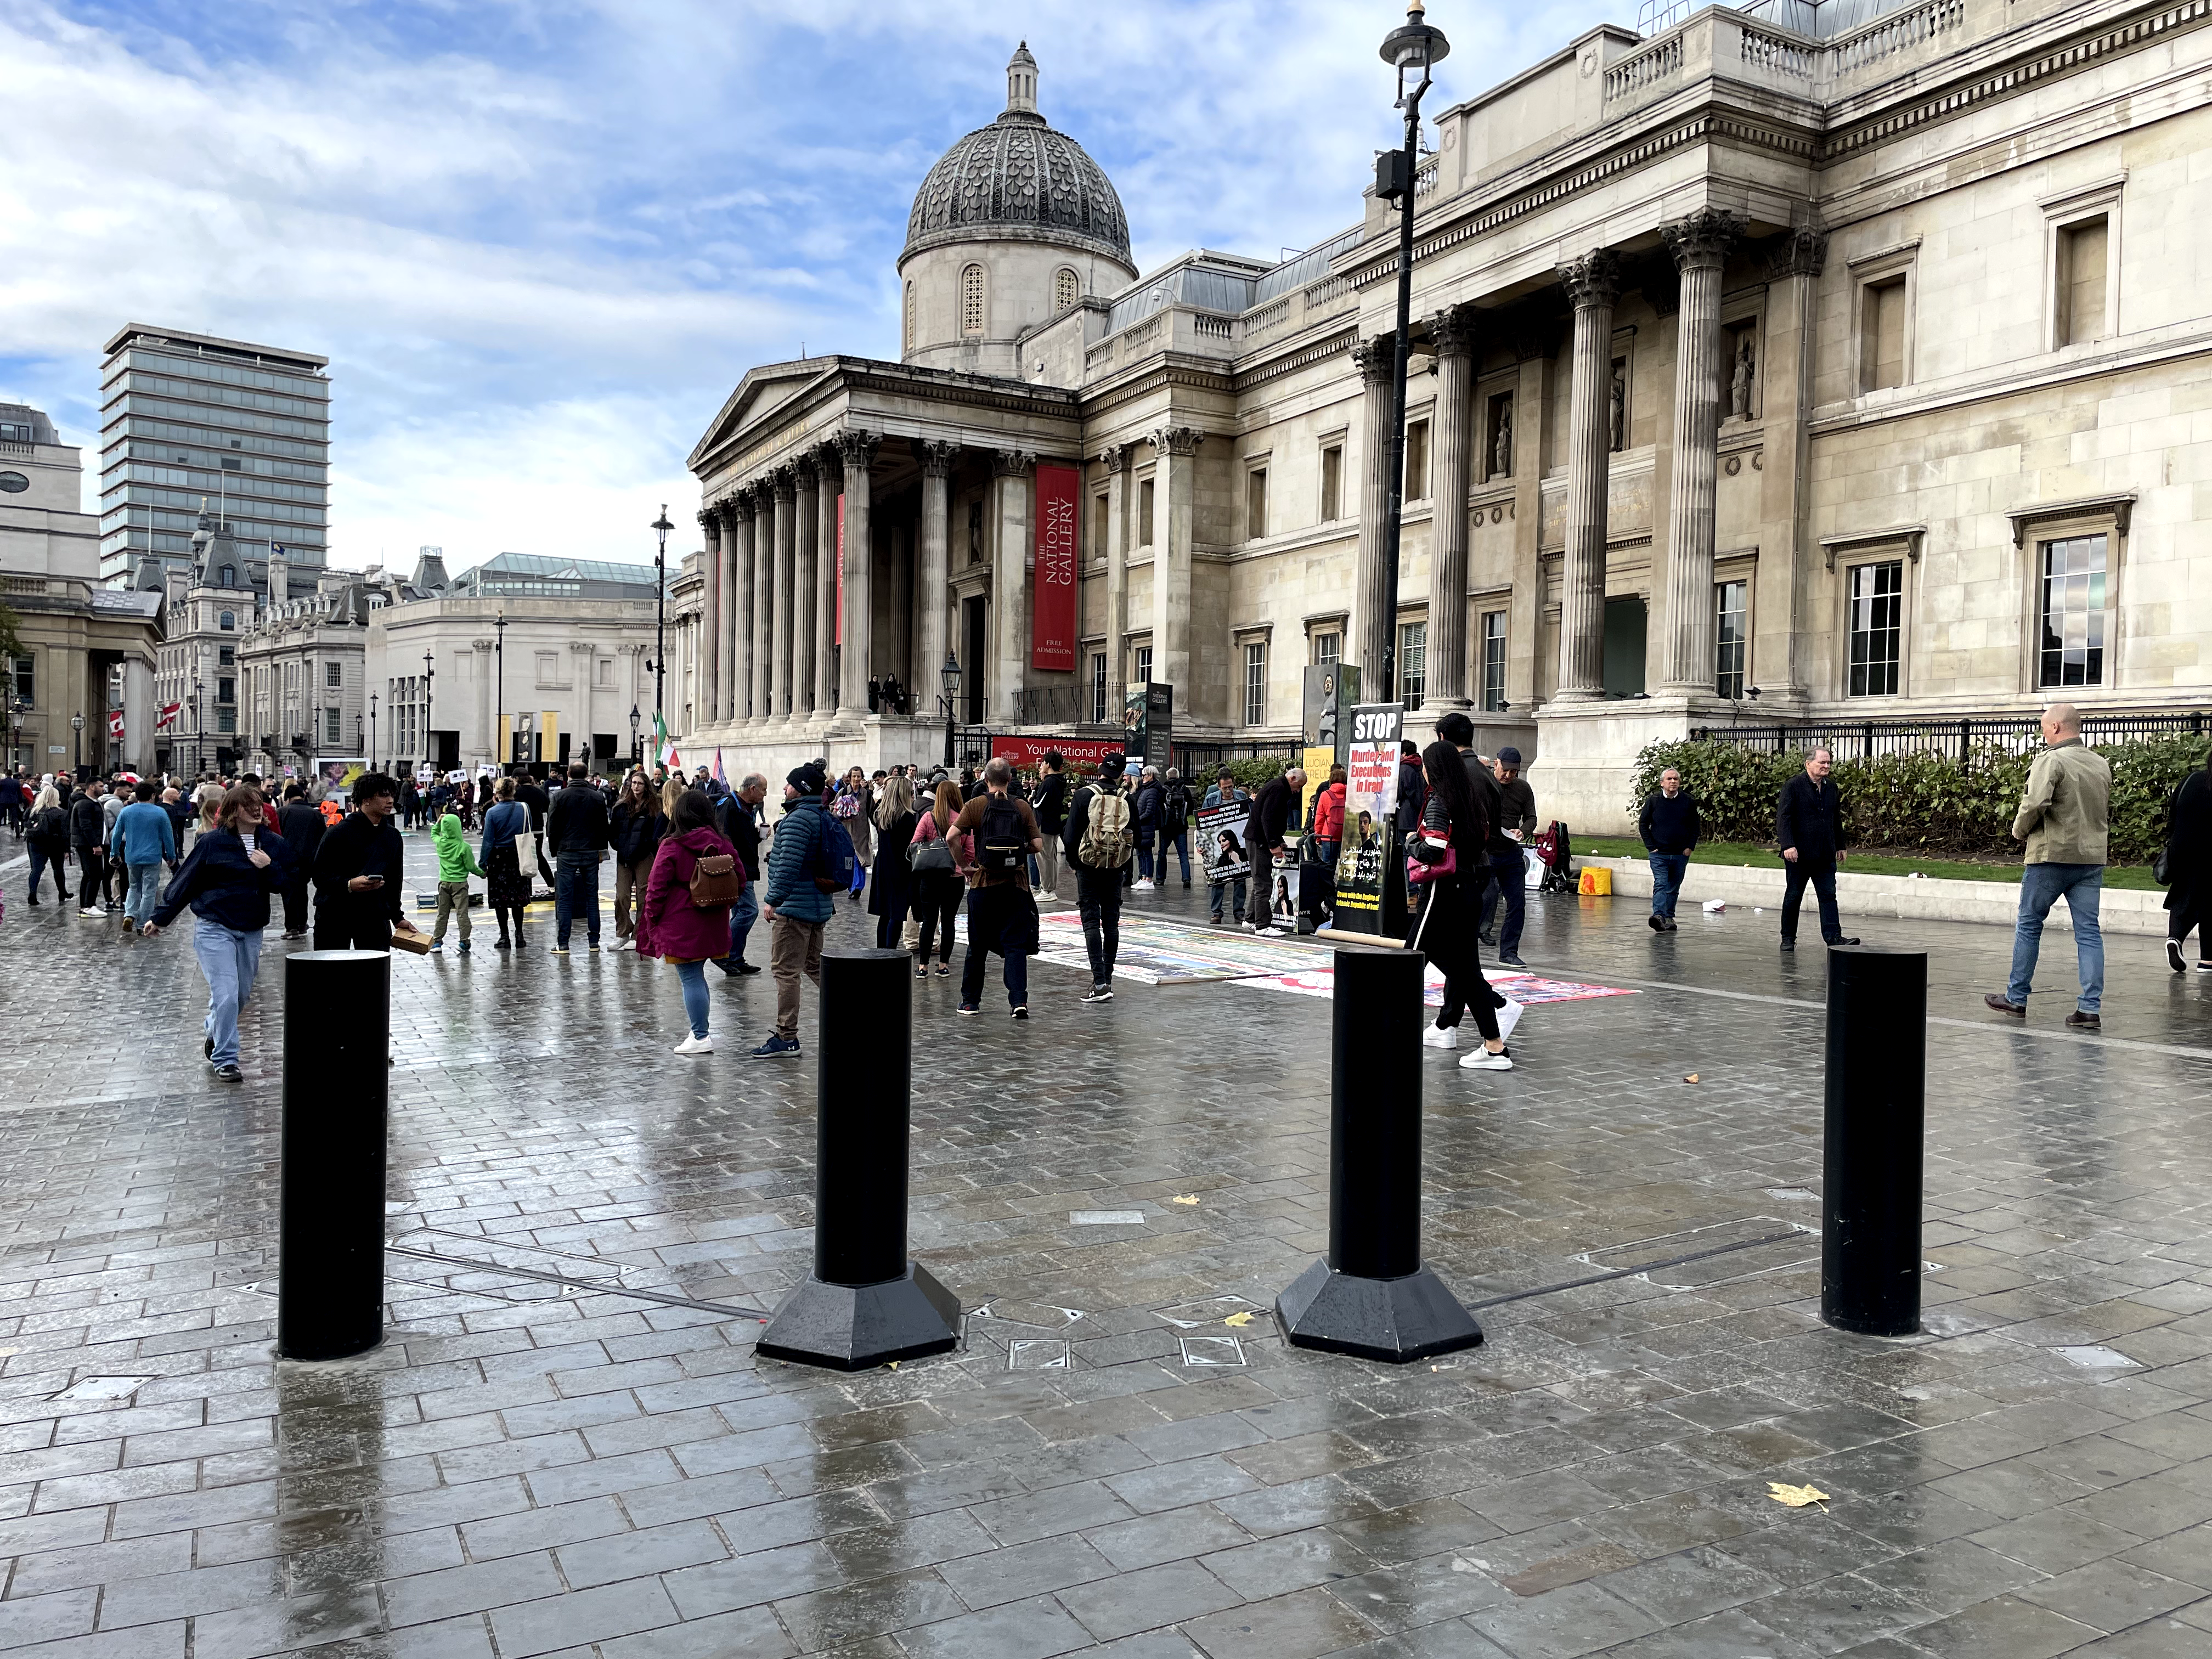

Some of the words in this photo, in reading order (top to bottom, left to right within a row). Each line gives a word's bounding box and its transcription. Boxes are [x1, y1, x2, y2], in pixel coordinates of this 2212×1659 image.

[1046, 497, 1058, 584] NATIONAL
[1059, 498, 1073, 585] GALLERY
[1355, 713, 1397, 740] STOP
[1025, 743, 1051, 755] Your
[1054, 744, 1097, 758] National
[1351, 749, 1379, 763] Murder
[1380, 748, 1395, 762] and
[1306, 758, 1331, 768] LUCIAN
[1306, 769, 1331, 779] FREUD
[1351, 765, 1392, 777] Executions
[1356, 780, 1363, 792] in
[1364, 780, 1384, 793] Iran!
